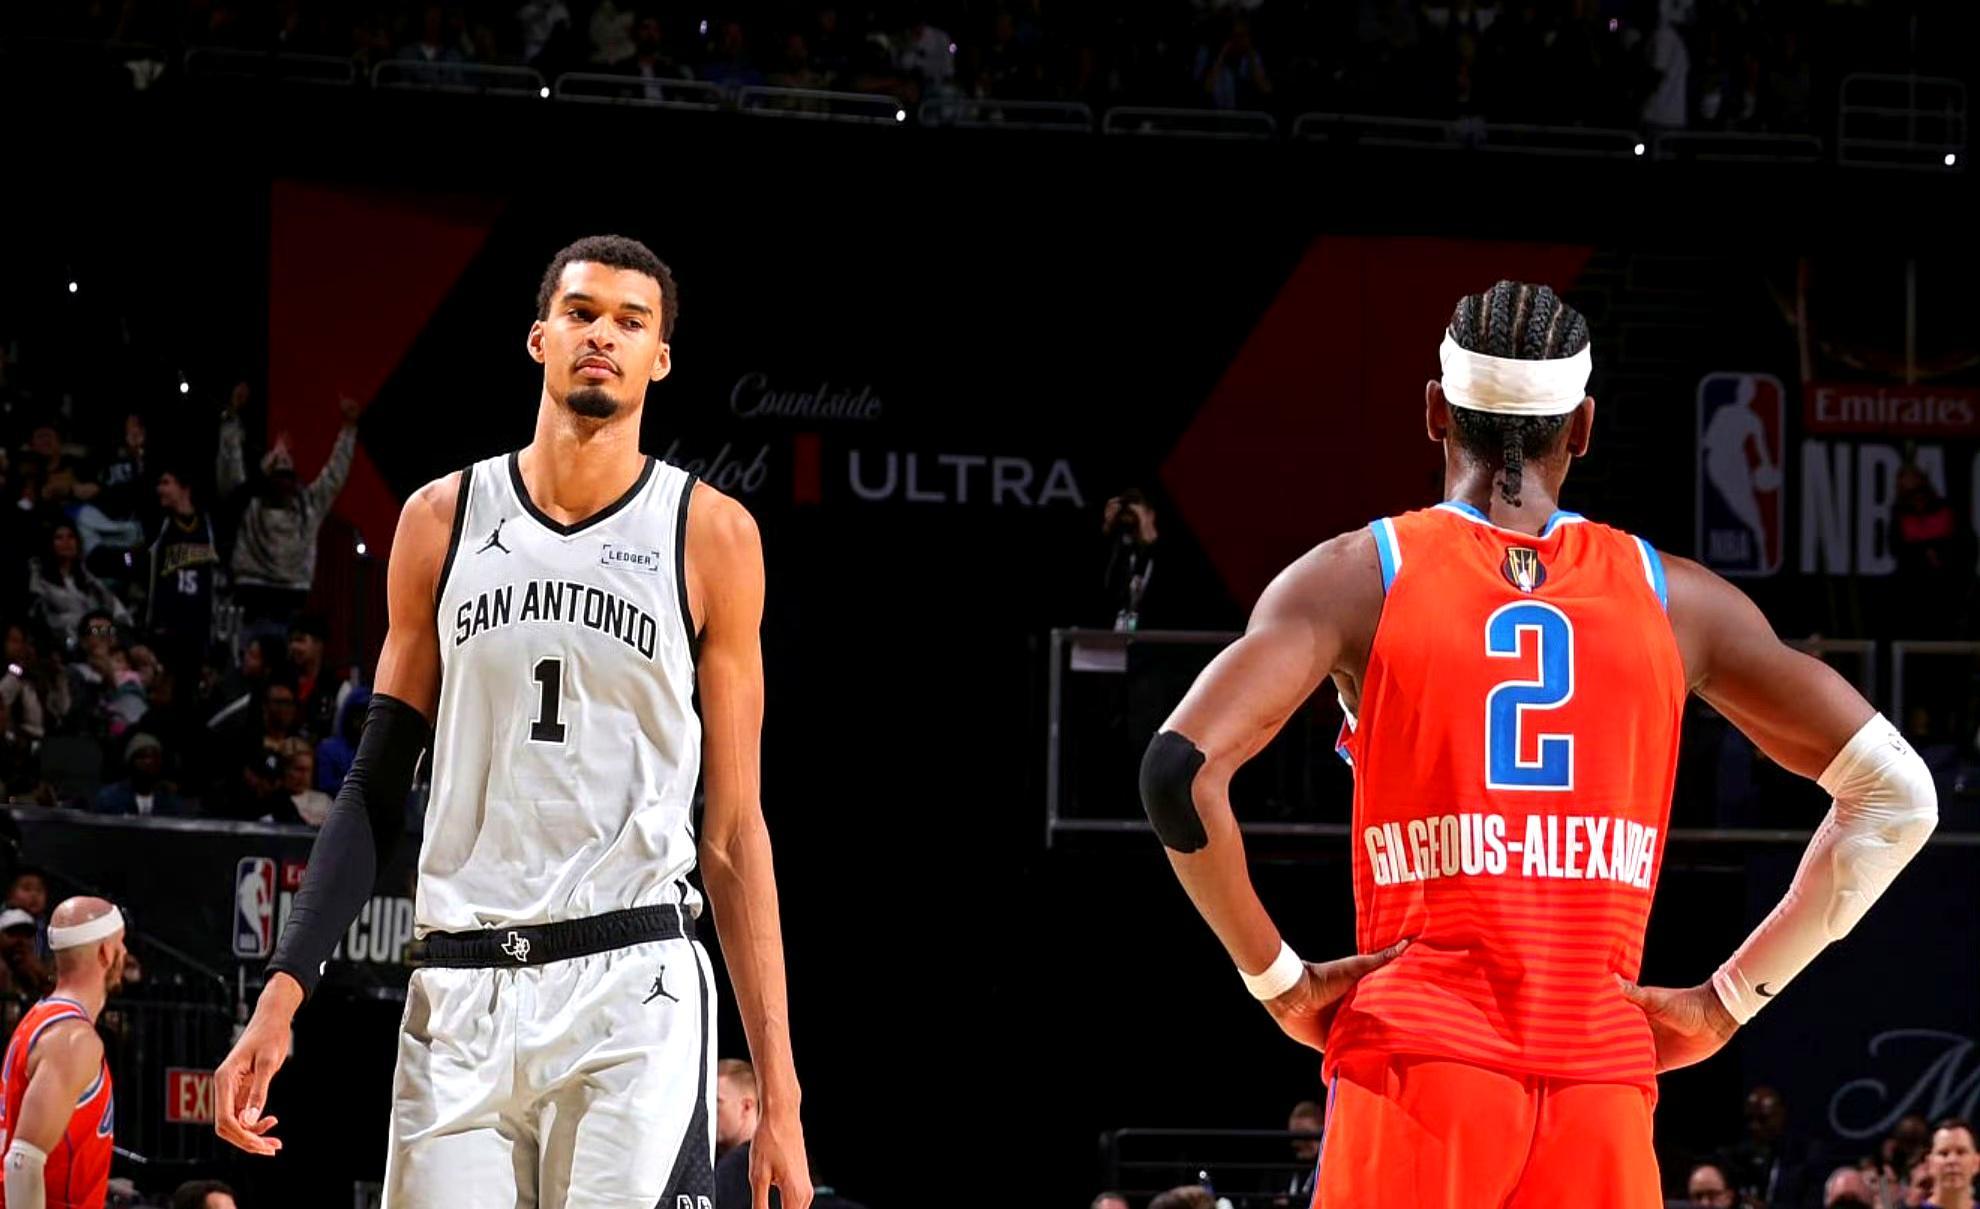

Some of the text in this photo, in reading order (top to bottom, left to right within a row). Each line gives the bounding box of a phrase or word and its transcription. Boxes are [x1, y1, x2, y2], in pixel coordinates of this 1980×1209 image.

[729, 371, 883, 420] Courtside
[1814, 386, 1976, 427] Emirates
[848, 448, 1087, 509] ULTRA
[177, 568, 200, 595] 15
[608, 550, 651, 565] LEDGER
[455, 580, 657, 660] SAN ANTONIO
[529, 656, 567, 743] 1
[1485, 600, 1574, 791] 2
[347, 895, 415, 964] CUP
[179, 1073, 215, 1121] EXI
